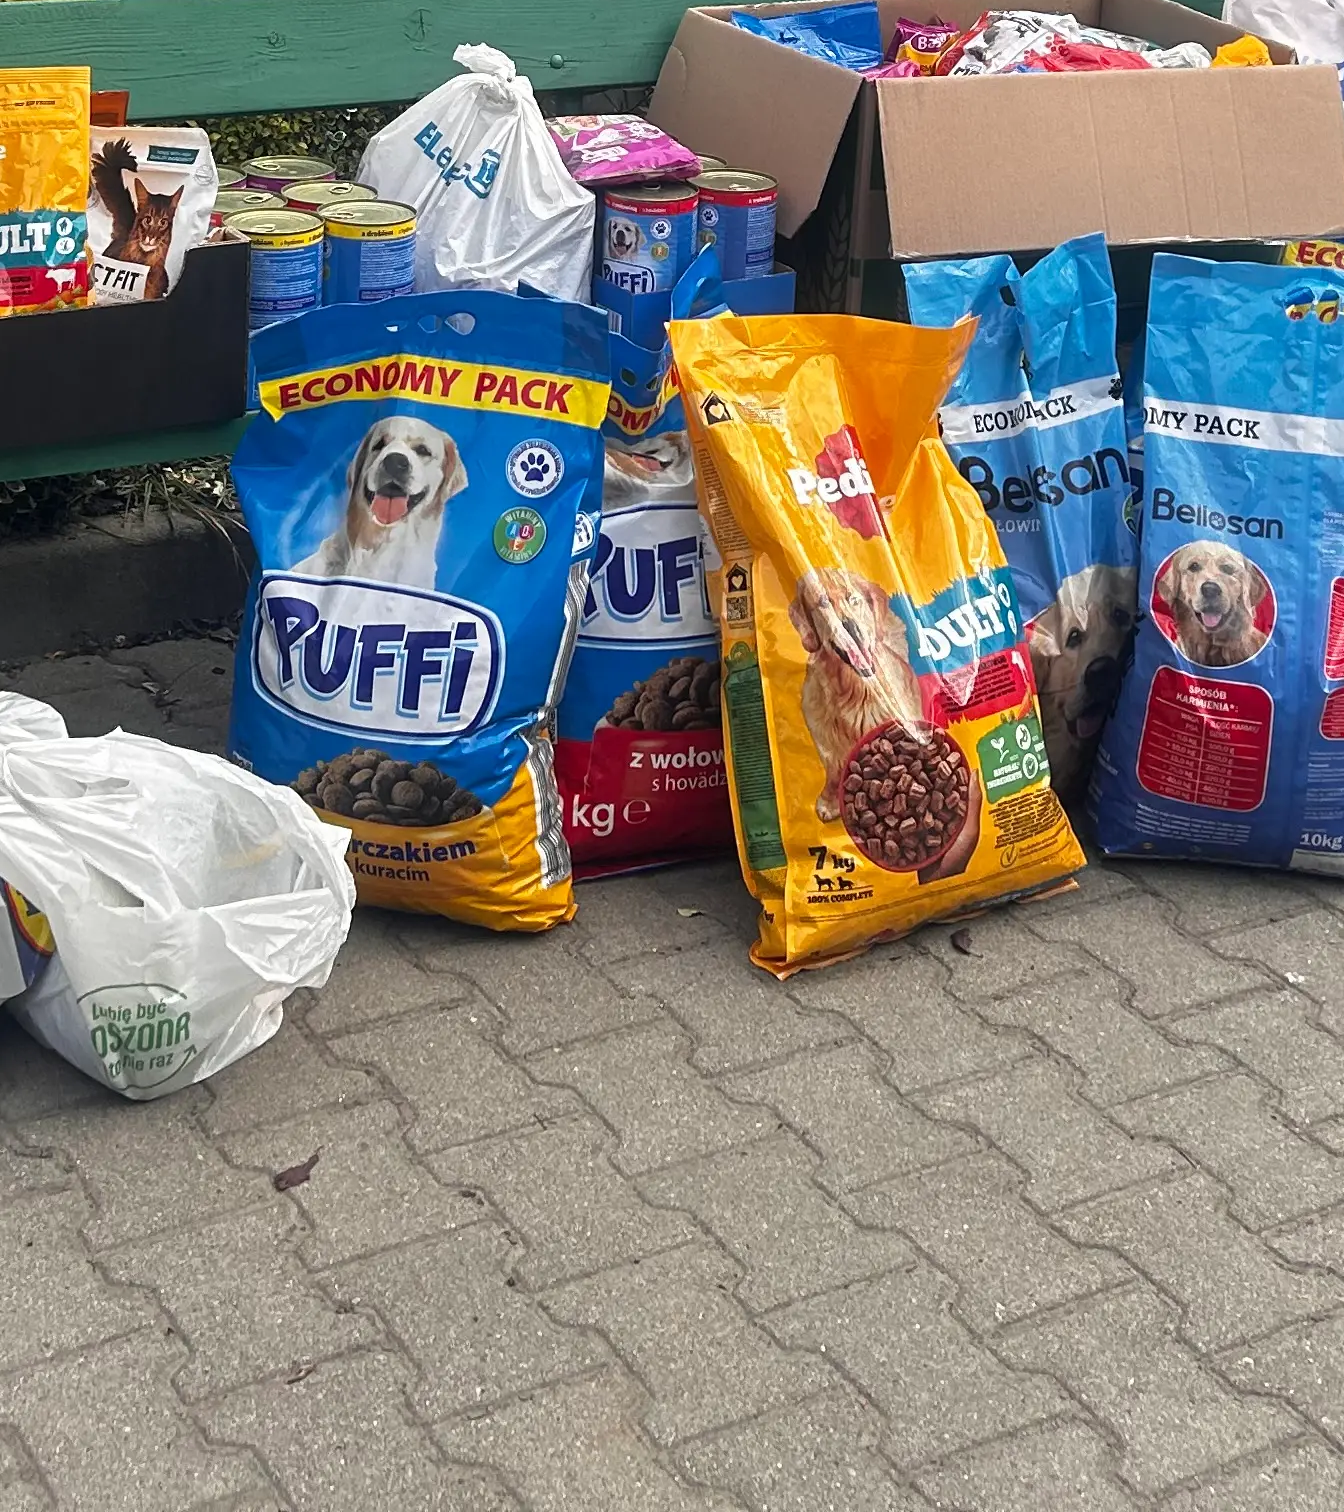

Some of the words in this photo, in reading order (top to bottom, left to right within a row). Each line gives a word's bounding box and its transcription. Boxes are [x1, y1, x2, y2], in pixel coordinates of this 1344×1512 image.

[112, 269, 140, 292] FIT
[278, 360, 463, 410] ECONOMY
[473, 371, 575, 415] PACK
[1193, 413, 1261, 440] PACK
[786, 456, 875, 505] Pedi
[1151, 488, 1284, 539] Bellosan
[1188, 684, 1227, 700] SPOSÓB
[629, 751, 645, 769] z
[650, 745, 726, 769] wołow
[651, 778, 660, 792] s
[665, 769, 728, 792] hovädz
[571, 794, 616, 837] kg
[350, 838, 477, 864] rczakiem
[1299, 833, 1344, 850] 10kg
[808, 845, 828, 870] 7
[830, 854, 856, 873] kg
[806, 894, 830, 905] 100%
[830, 889, 874, 903] COMPLETE
[136, 998, 168, 1020] być
[90, 1011, 192, 1059] OSZONA
[149, 1052, 175, 1070] raz
